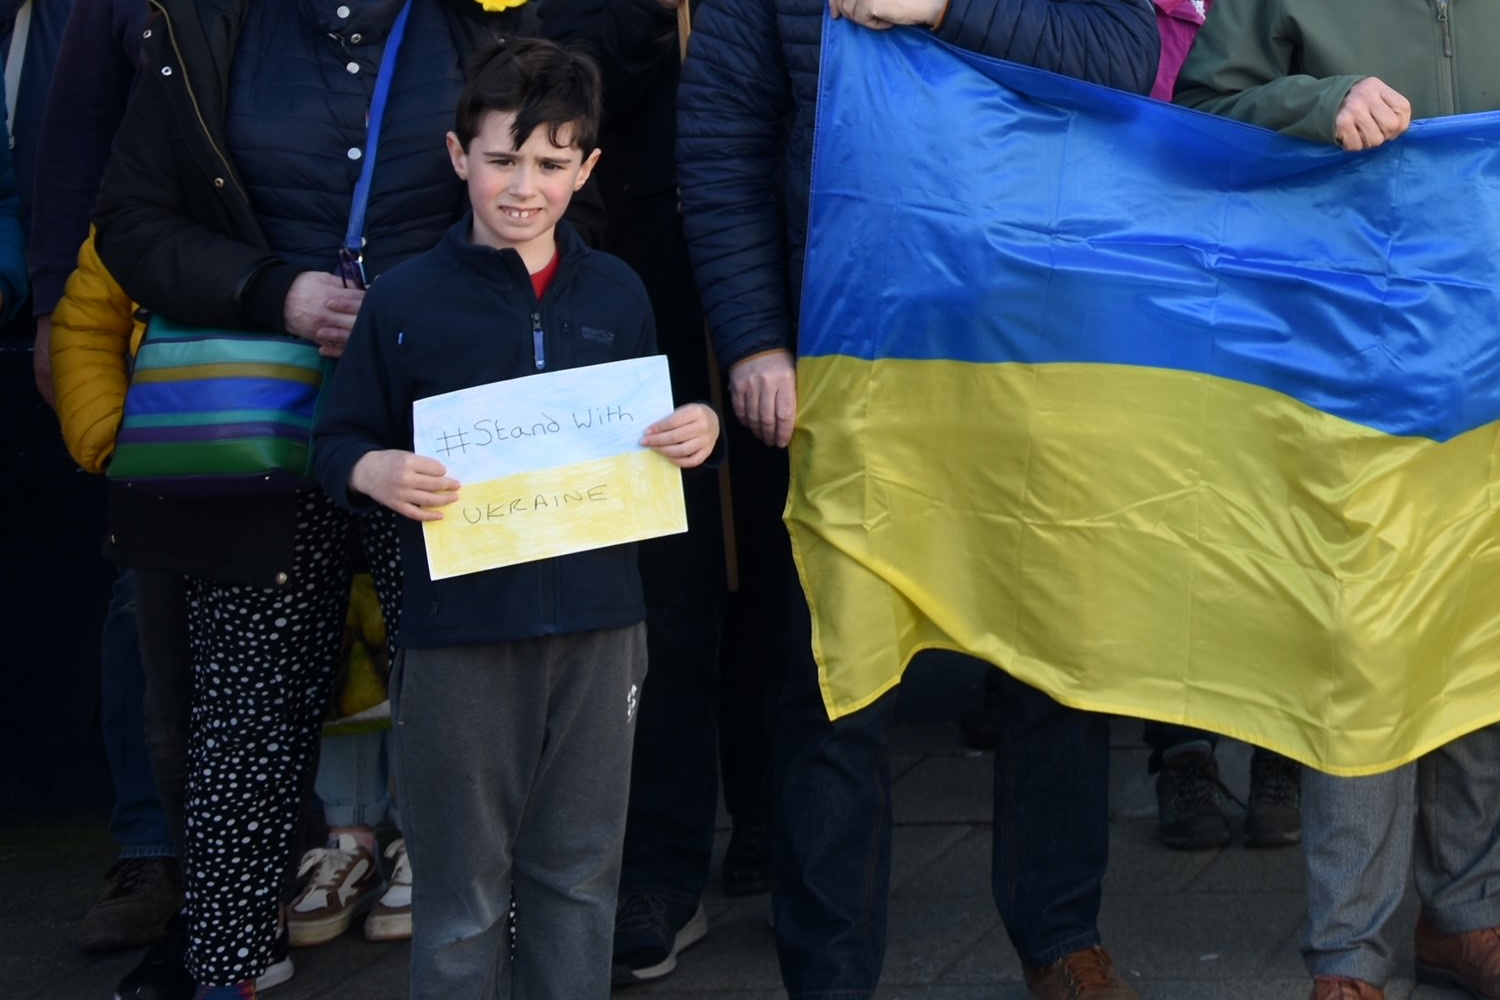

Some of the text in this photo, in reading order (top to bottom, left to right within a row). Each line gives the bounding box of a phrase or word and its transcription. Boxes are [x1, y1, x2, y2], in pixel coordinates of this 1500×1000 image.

[436, 405, 634, 457] #Stand With
[463, 484, 608, 524] UKRAINE
